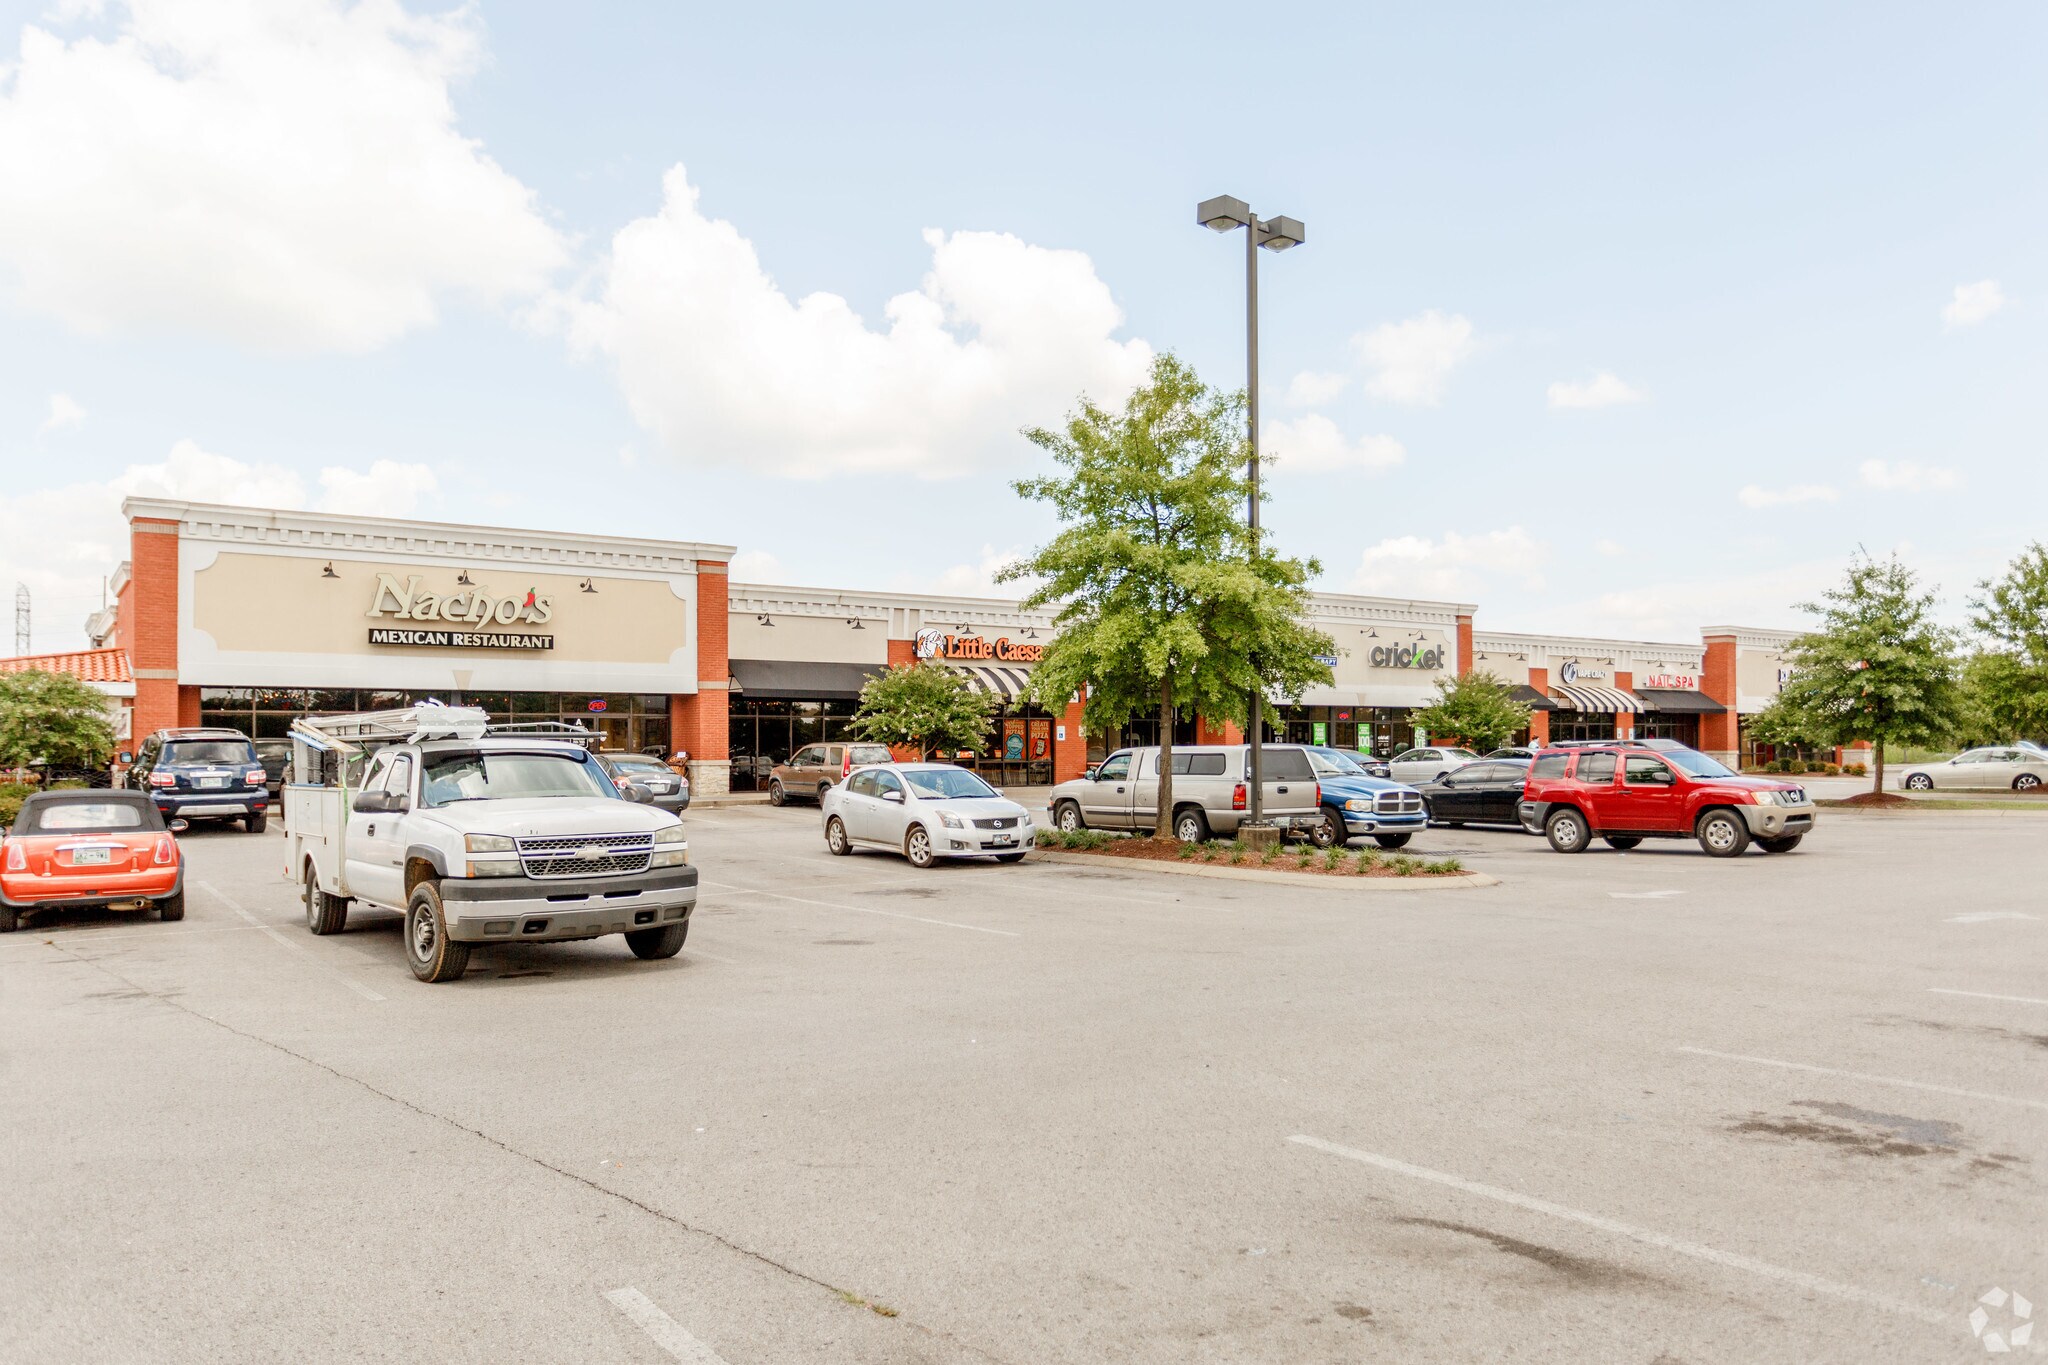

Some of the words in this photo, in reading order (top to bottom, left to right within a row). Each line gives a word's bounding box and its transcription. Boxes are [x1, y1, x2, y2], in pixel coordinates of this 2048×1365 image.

[365, 573, 555, 630] Nacho's
[372, 630, 448, 645] MEXICAN
[452, 634, 552, 649] RESTAURANT
[945, 635, 993, 659] Little
[995, 637, 1044, 661] Caesa
[1370, 642, 1445, 669] cricket
[1675, 675, 1694, 688] SPA
